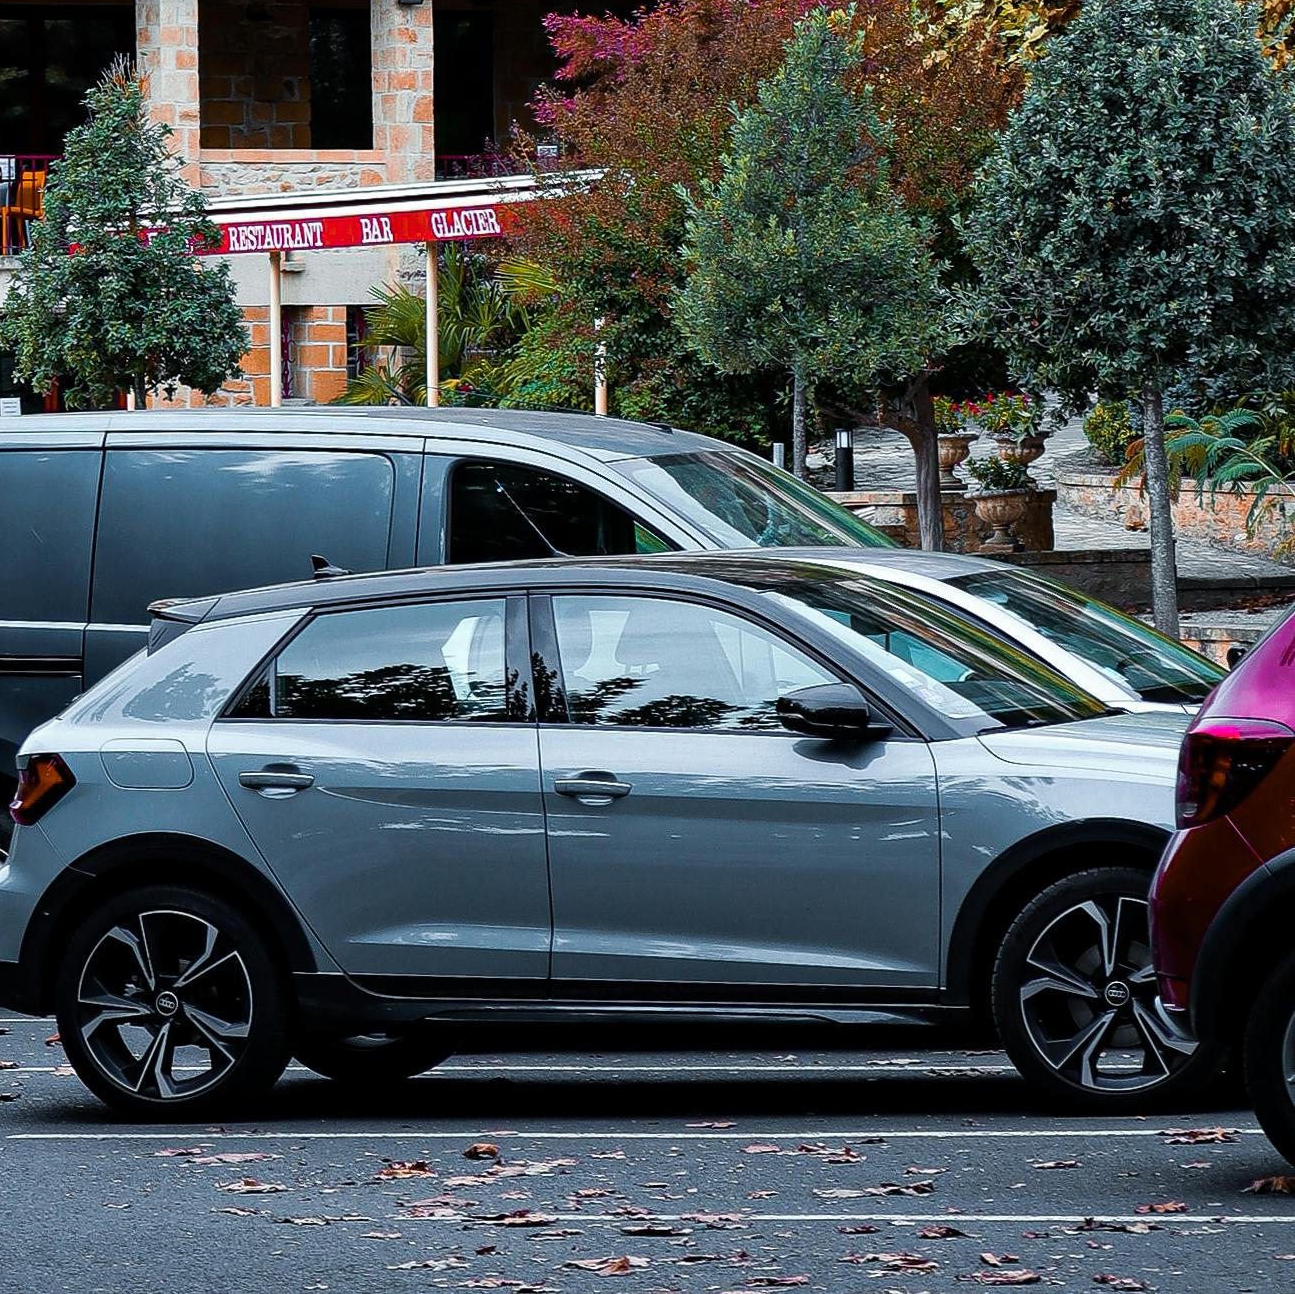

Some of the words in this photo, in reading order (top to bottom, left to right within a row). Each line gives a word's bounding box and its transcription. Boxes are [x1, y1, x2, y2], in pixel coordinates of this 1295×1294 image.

[227, 222, 324, 251] RESTAURANT
[360, 217, 393, 243] BAR
[431, 209, 500, 238] GLACIER
